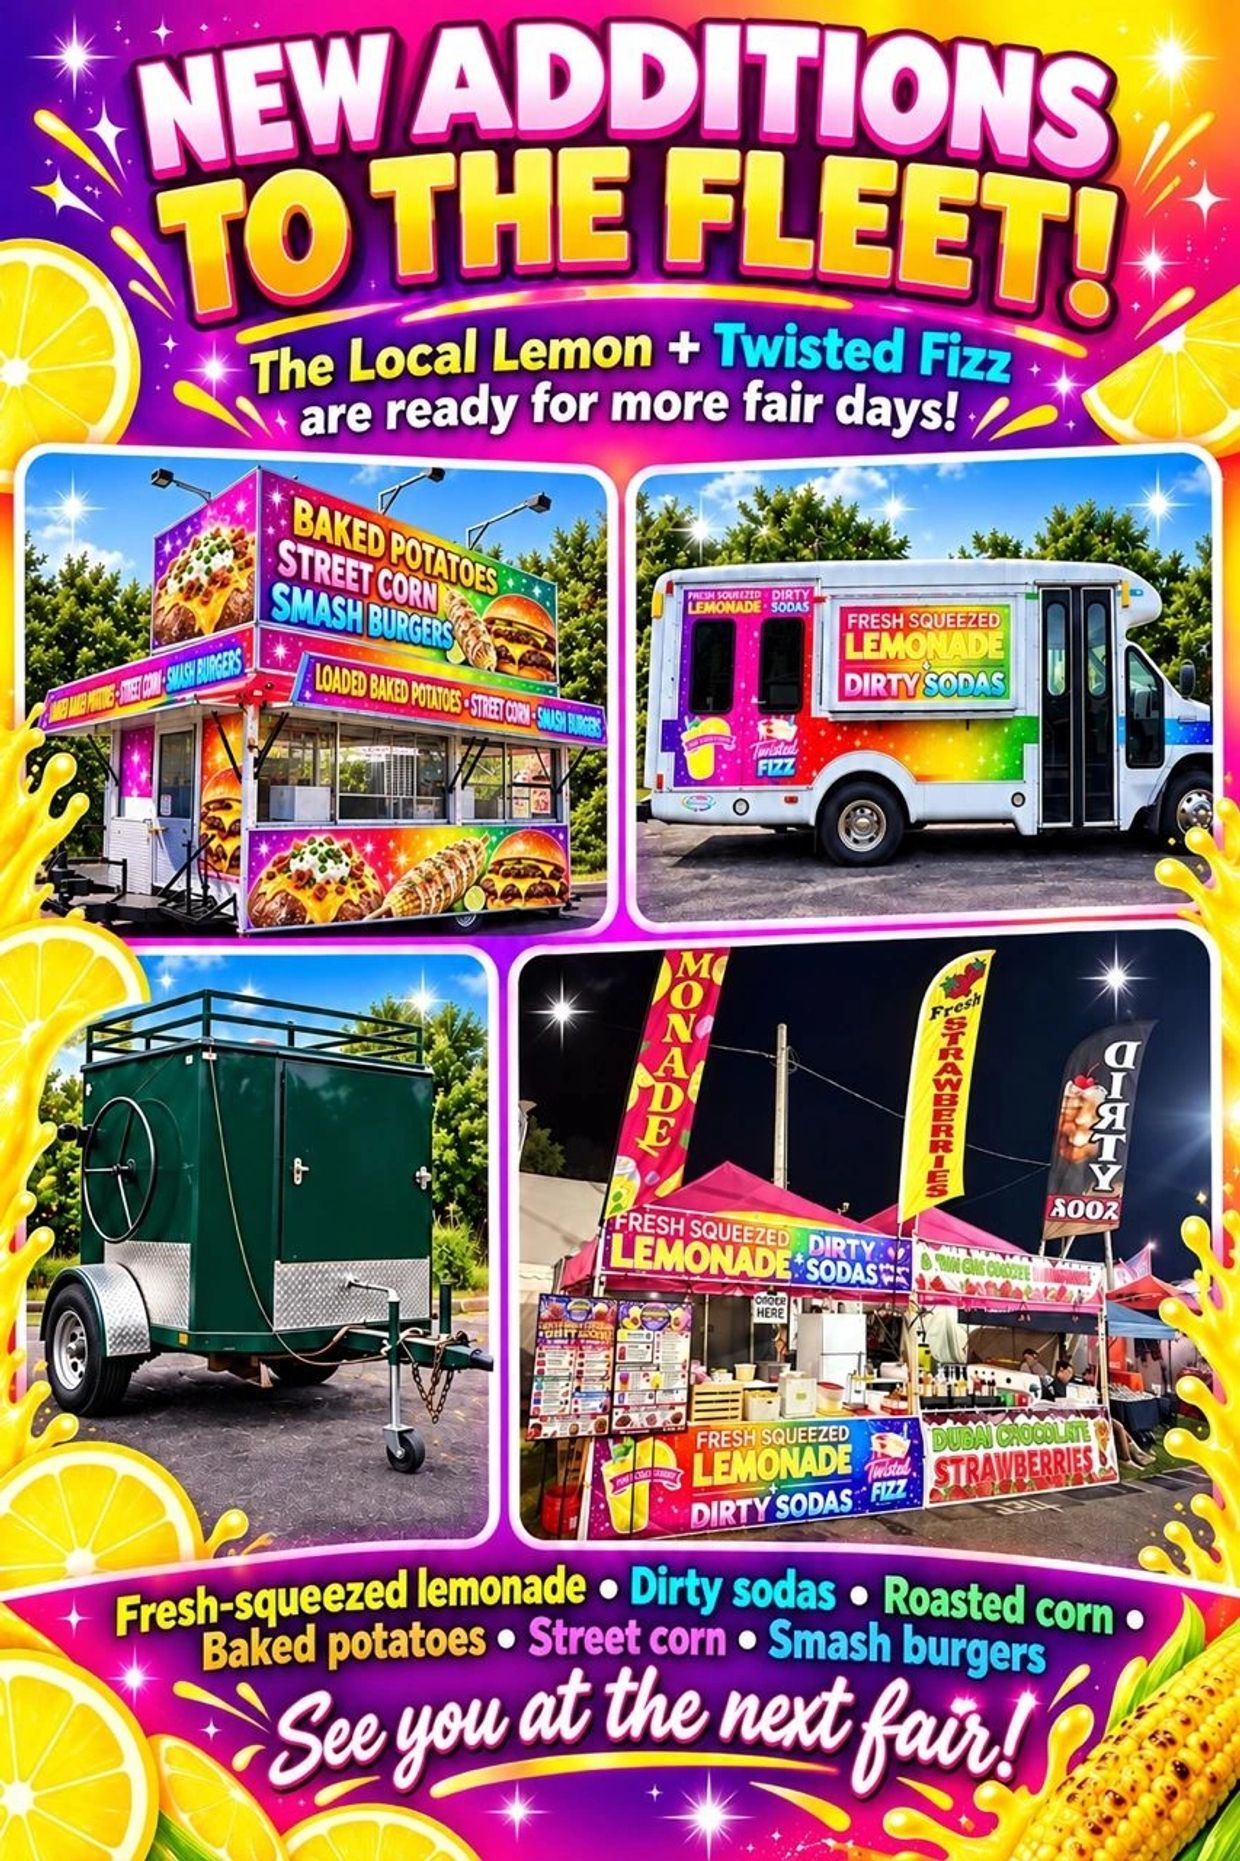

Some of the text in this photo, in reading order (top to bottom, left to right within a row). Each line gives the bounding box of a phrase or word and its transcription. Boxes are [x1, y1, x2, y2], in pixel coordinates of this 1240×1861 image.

[293, 497, 499, 596] BAKED POTATOES
[277, 539, 438, 612] STREET CORN
[687, 600, 761, 614] LEMONADE
[771, 589, 810, 600] DIRTY
[771, 601, 810, 612] SODAS
[271, 582, 454, 649] SMASH BURGERS
[847, 612, 1000, 629] FRESH SQUEEZED
[845, 631, 1004, 660] LEMONADE
[315, 662, 367, 698] LOADED
[369, 673, 408, 703] BAKED
[411, 681, 462, 713] POTATOES
[470, 693, 503, 720] STREET
[505, 700, 531, 726] CORN
[537, 706, 567, 732] SMASH
[844, 672, 1005, 697] DIRTY SODAS
[757, 758, 796, 776] FIZZ
[929, 992, 981, 1021] Fresh
[925, 1016, 968, 1198] STRAWBERRIES
[615, 1211, 790, 1247] FRESH SQUEEZED
[610, 1232, 792, 1280] LEMONADE
[808, 1234, 876, 1260] DIRTY
[805, 1259, 878, 1285] SODAS
[757, 1307, 784, 1319] HERE
[697, 1425, 849, 1449] FRESH SQUEEZED
[932, 1425, 993, 1452] DUBAI
[693, 1444, 853, 1487] LEMONADE
[864, 1456, 912, 1482] Twisted
[934, 1445, 1093, 1487] STRAWBERRIES
[871, 1479, 907, 1502] FIZZ
[690, 1489, 854, 1529] DIRTY SODAS
